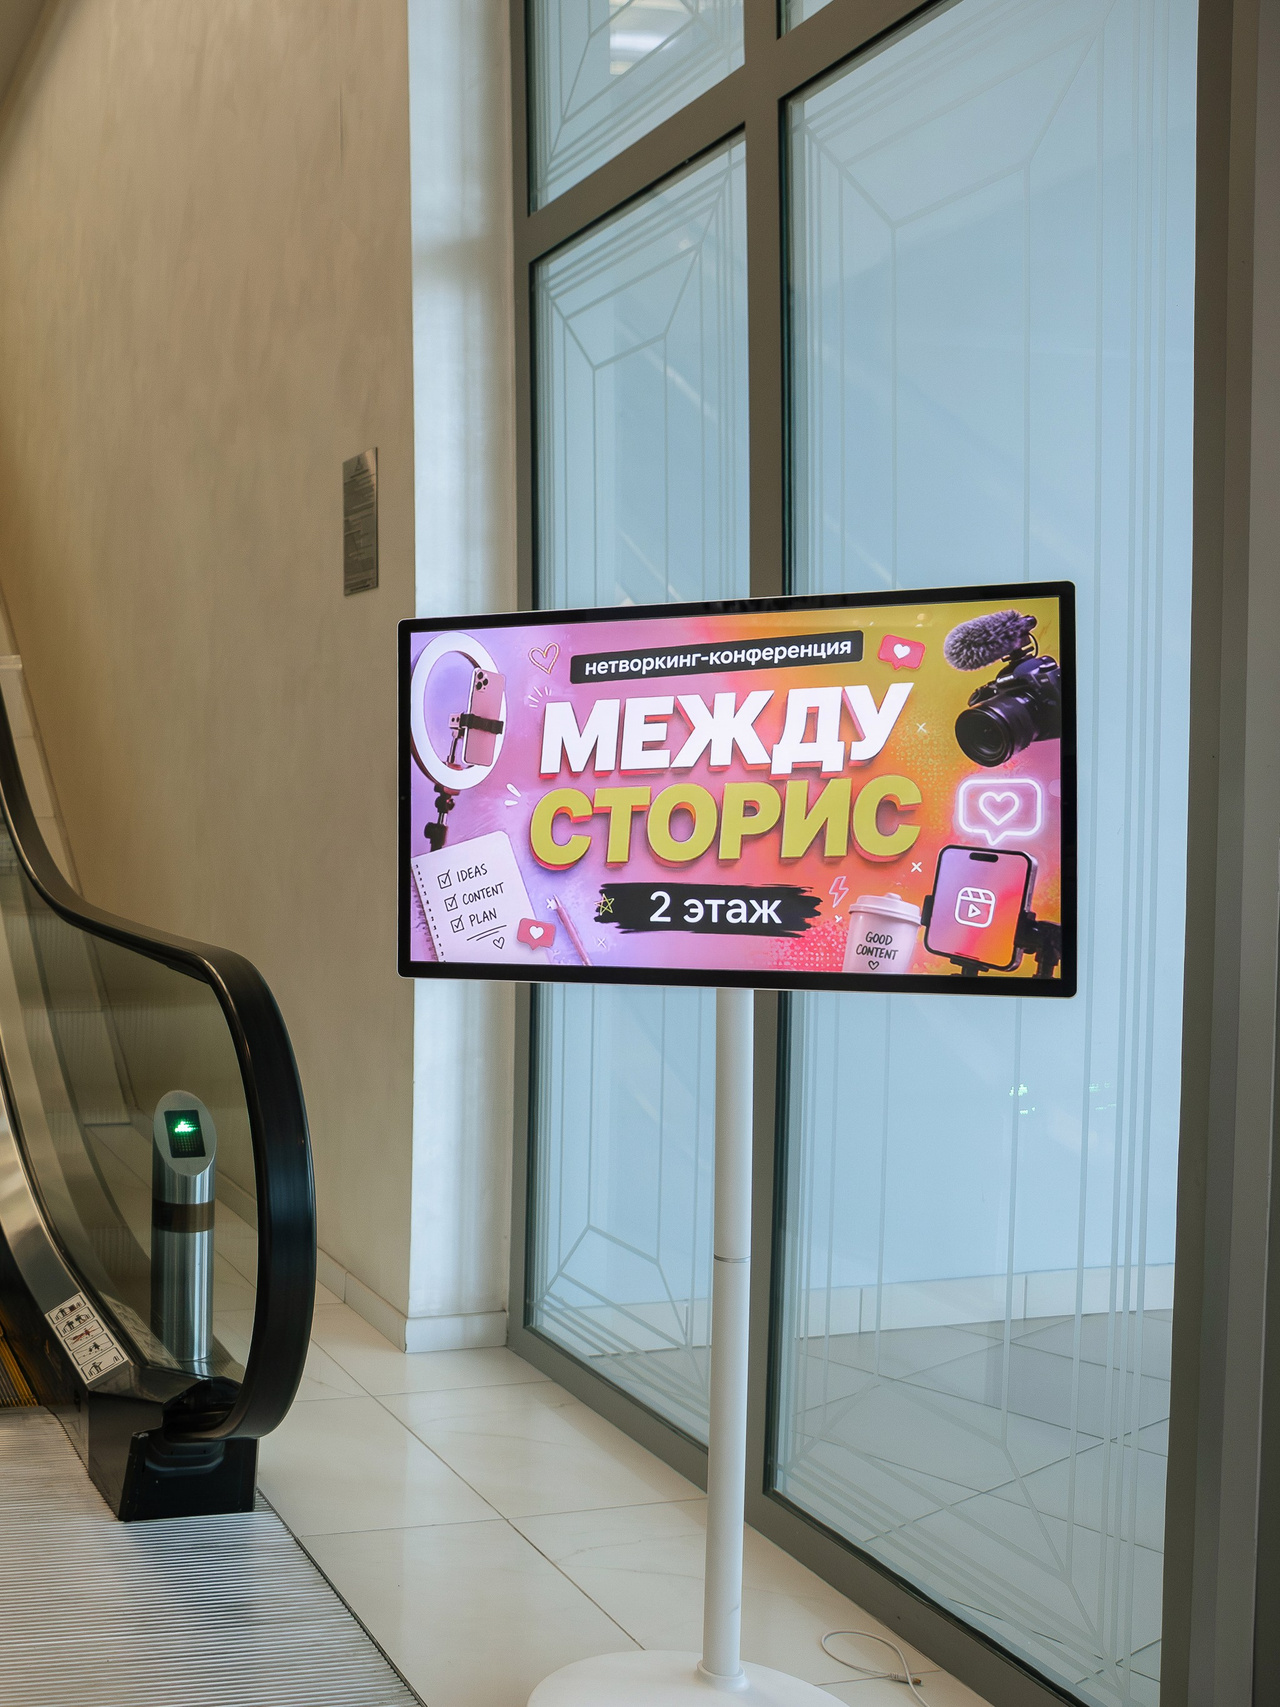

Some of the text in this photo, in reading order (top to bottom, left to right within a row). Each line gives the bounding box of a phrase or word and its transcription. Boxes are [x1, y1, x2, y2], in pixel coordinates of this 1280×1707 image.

[584, 639, 852, 676] нетворкинг-конференция
[538, 682, 915, 777] МЕЖДУ
[529, 774, 923, 868] СТОРИС
[456, 863, 488, 883] IDEAS
[462, 882, 504, 905] CONTENT
[468, 907, 498, 927] PLAN
[649, 890, 783, 924] 2 этаж
[865, 931, 893, 946] GOOD
[855, 943, 899, 961] CONTENT
